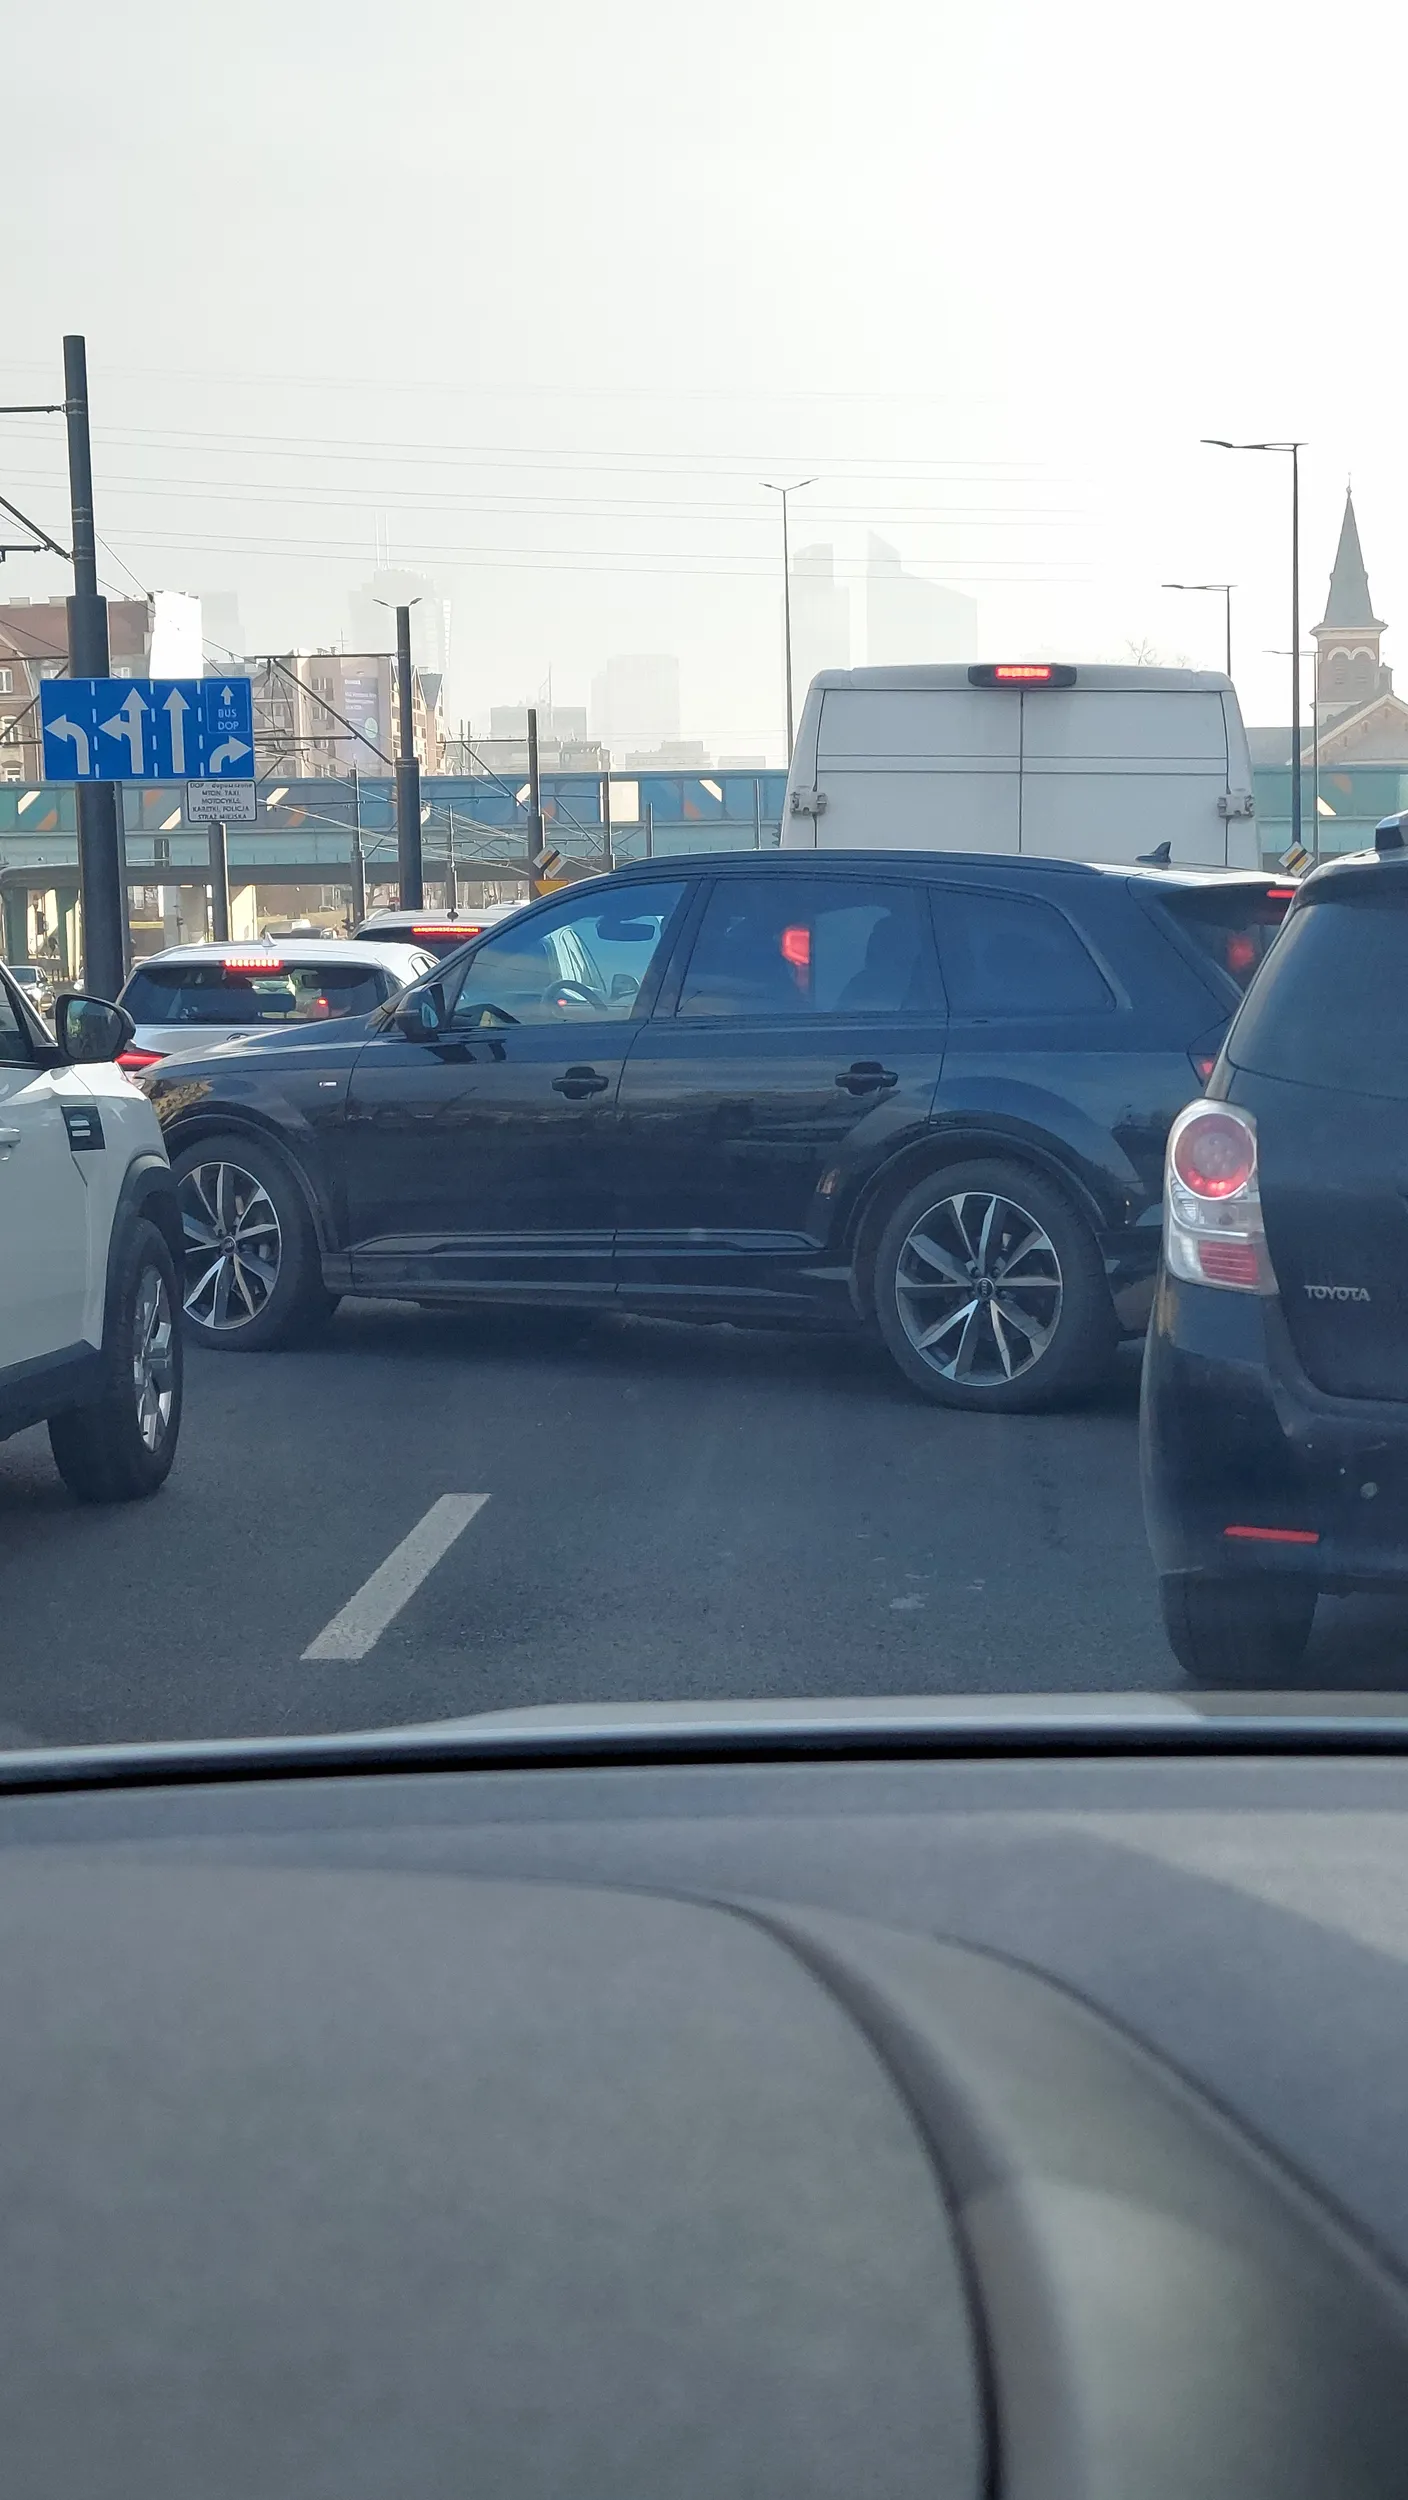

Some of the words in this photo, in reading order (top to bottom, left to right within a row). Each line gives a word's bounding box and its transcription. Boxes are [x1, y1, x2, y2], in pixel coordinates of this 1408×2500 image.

[218, 708, 237, 718] BUS
[217, 721, 239, 730] DOP
[1303, 1285, 1371, 1302] TOYOTA
